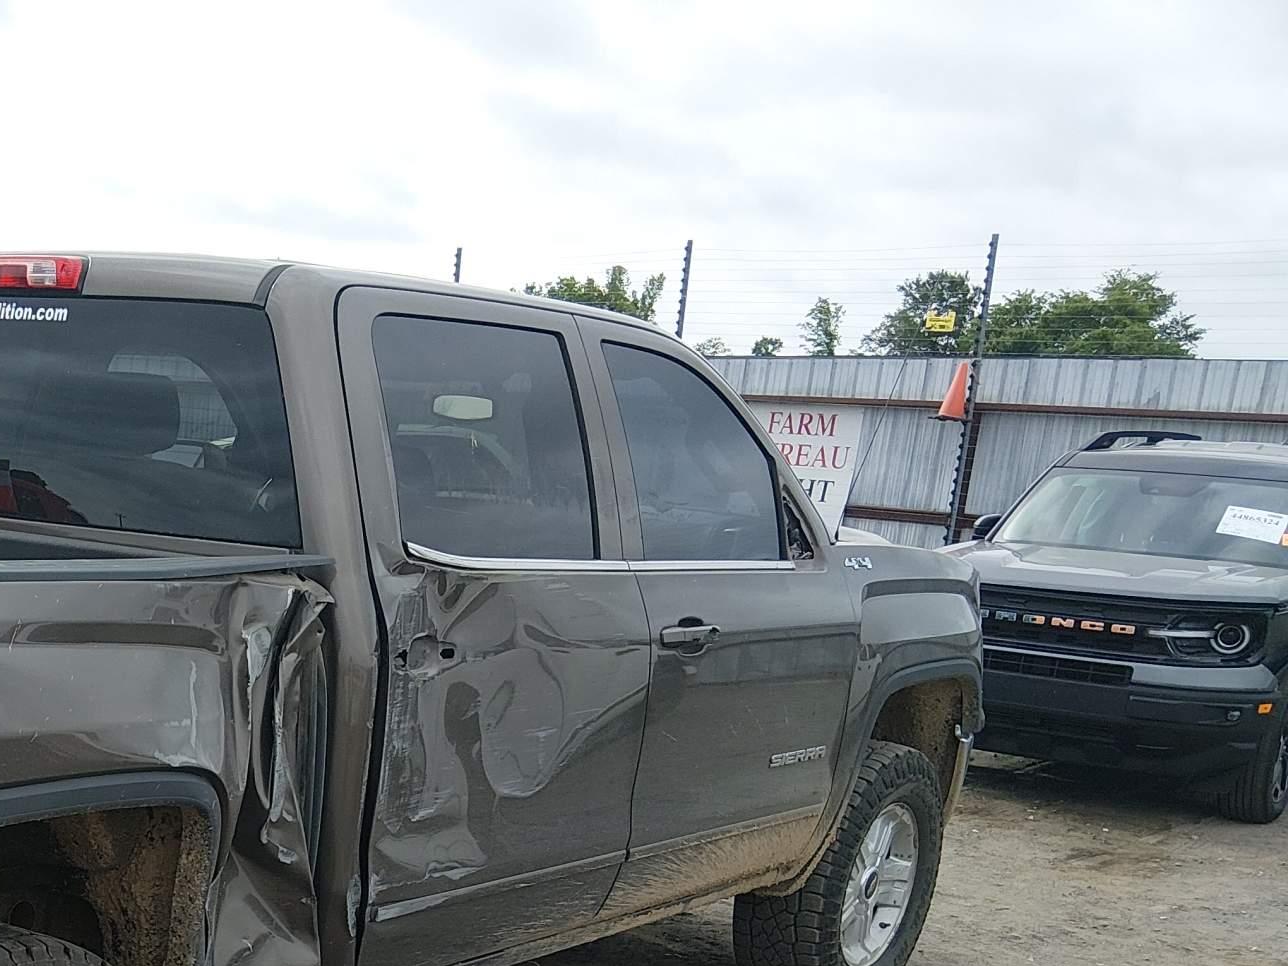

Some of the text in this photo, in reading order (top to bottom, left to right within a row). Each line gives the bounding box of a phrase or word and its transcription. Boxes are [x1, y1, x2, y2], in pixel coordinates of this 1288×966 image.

[768, 411, 838, 437] FARM
[776, 442, 851, 470] REAU
[768, 745, 826, 769] SIERRA
